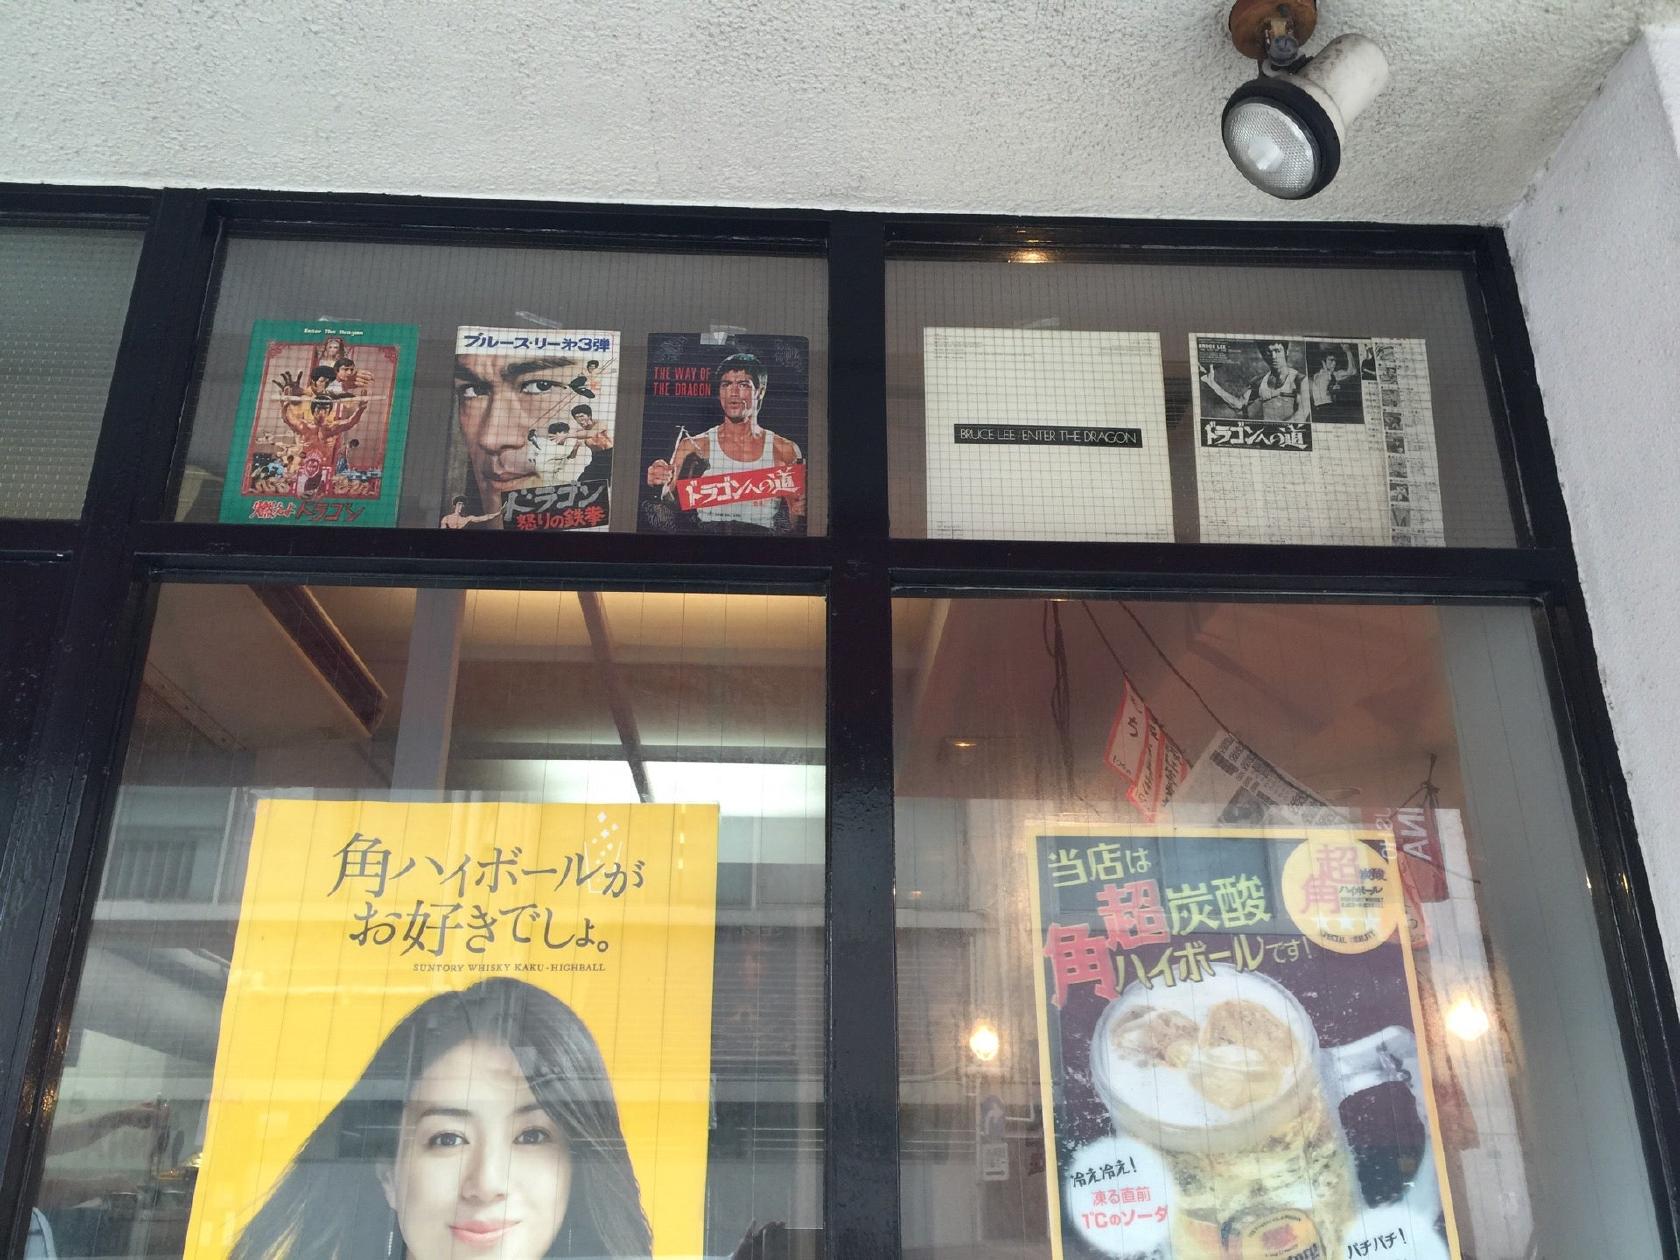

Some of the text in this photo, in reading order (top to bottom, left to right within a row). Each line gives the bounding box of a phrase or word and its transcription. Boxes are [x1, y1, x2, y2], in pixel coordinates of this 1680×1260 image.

[654, 366, 711, 381] THE WAY OF
[654, 382, 711, 397] THE DRAGON
[960, 428, 1137, 444] BRUCE LEE ENTER THE DRAGON
[1205, 421, 1308, 449] ドラゴンへの道
[504, 481, 606, 521] ドラゴン
[686, 468, 798, 507] ドラゴンへの道
[515, 505, 605, 531] 怒りの鉄拳
[327, 832, 646, 898] 角ハイボールが
[1048, 843, 1152, 888] 当店は
[349, 900, 609, 956] お好きでしょ。
[413, 963, 464, 972] SUNTORY
[468, 963, 510, 972] WHISKY
[1091, 1186, 1152, 1207] 凍る直前
